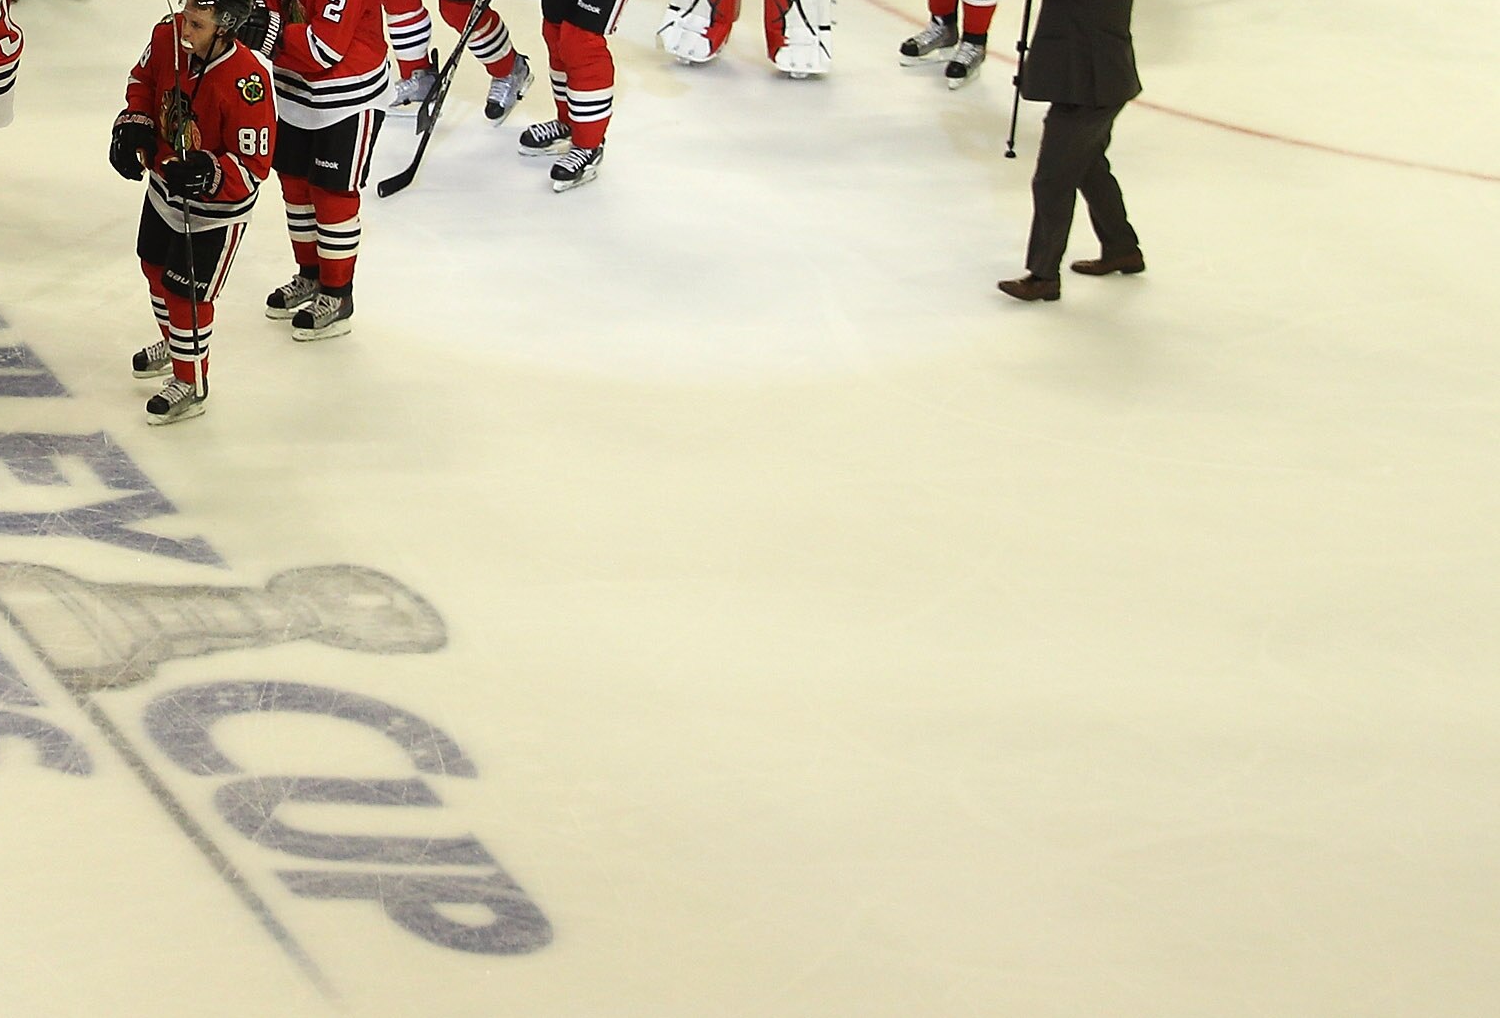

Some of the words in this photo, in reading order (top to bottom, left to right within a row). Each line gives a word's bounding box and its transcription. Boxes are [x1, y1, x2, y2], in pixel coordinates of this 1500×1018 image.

[237, 126, 270, 157] 88
[314, 157, 340, 170] Reebok
[142, 680, 556, 956] CUP
